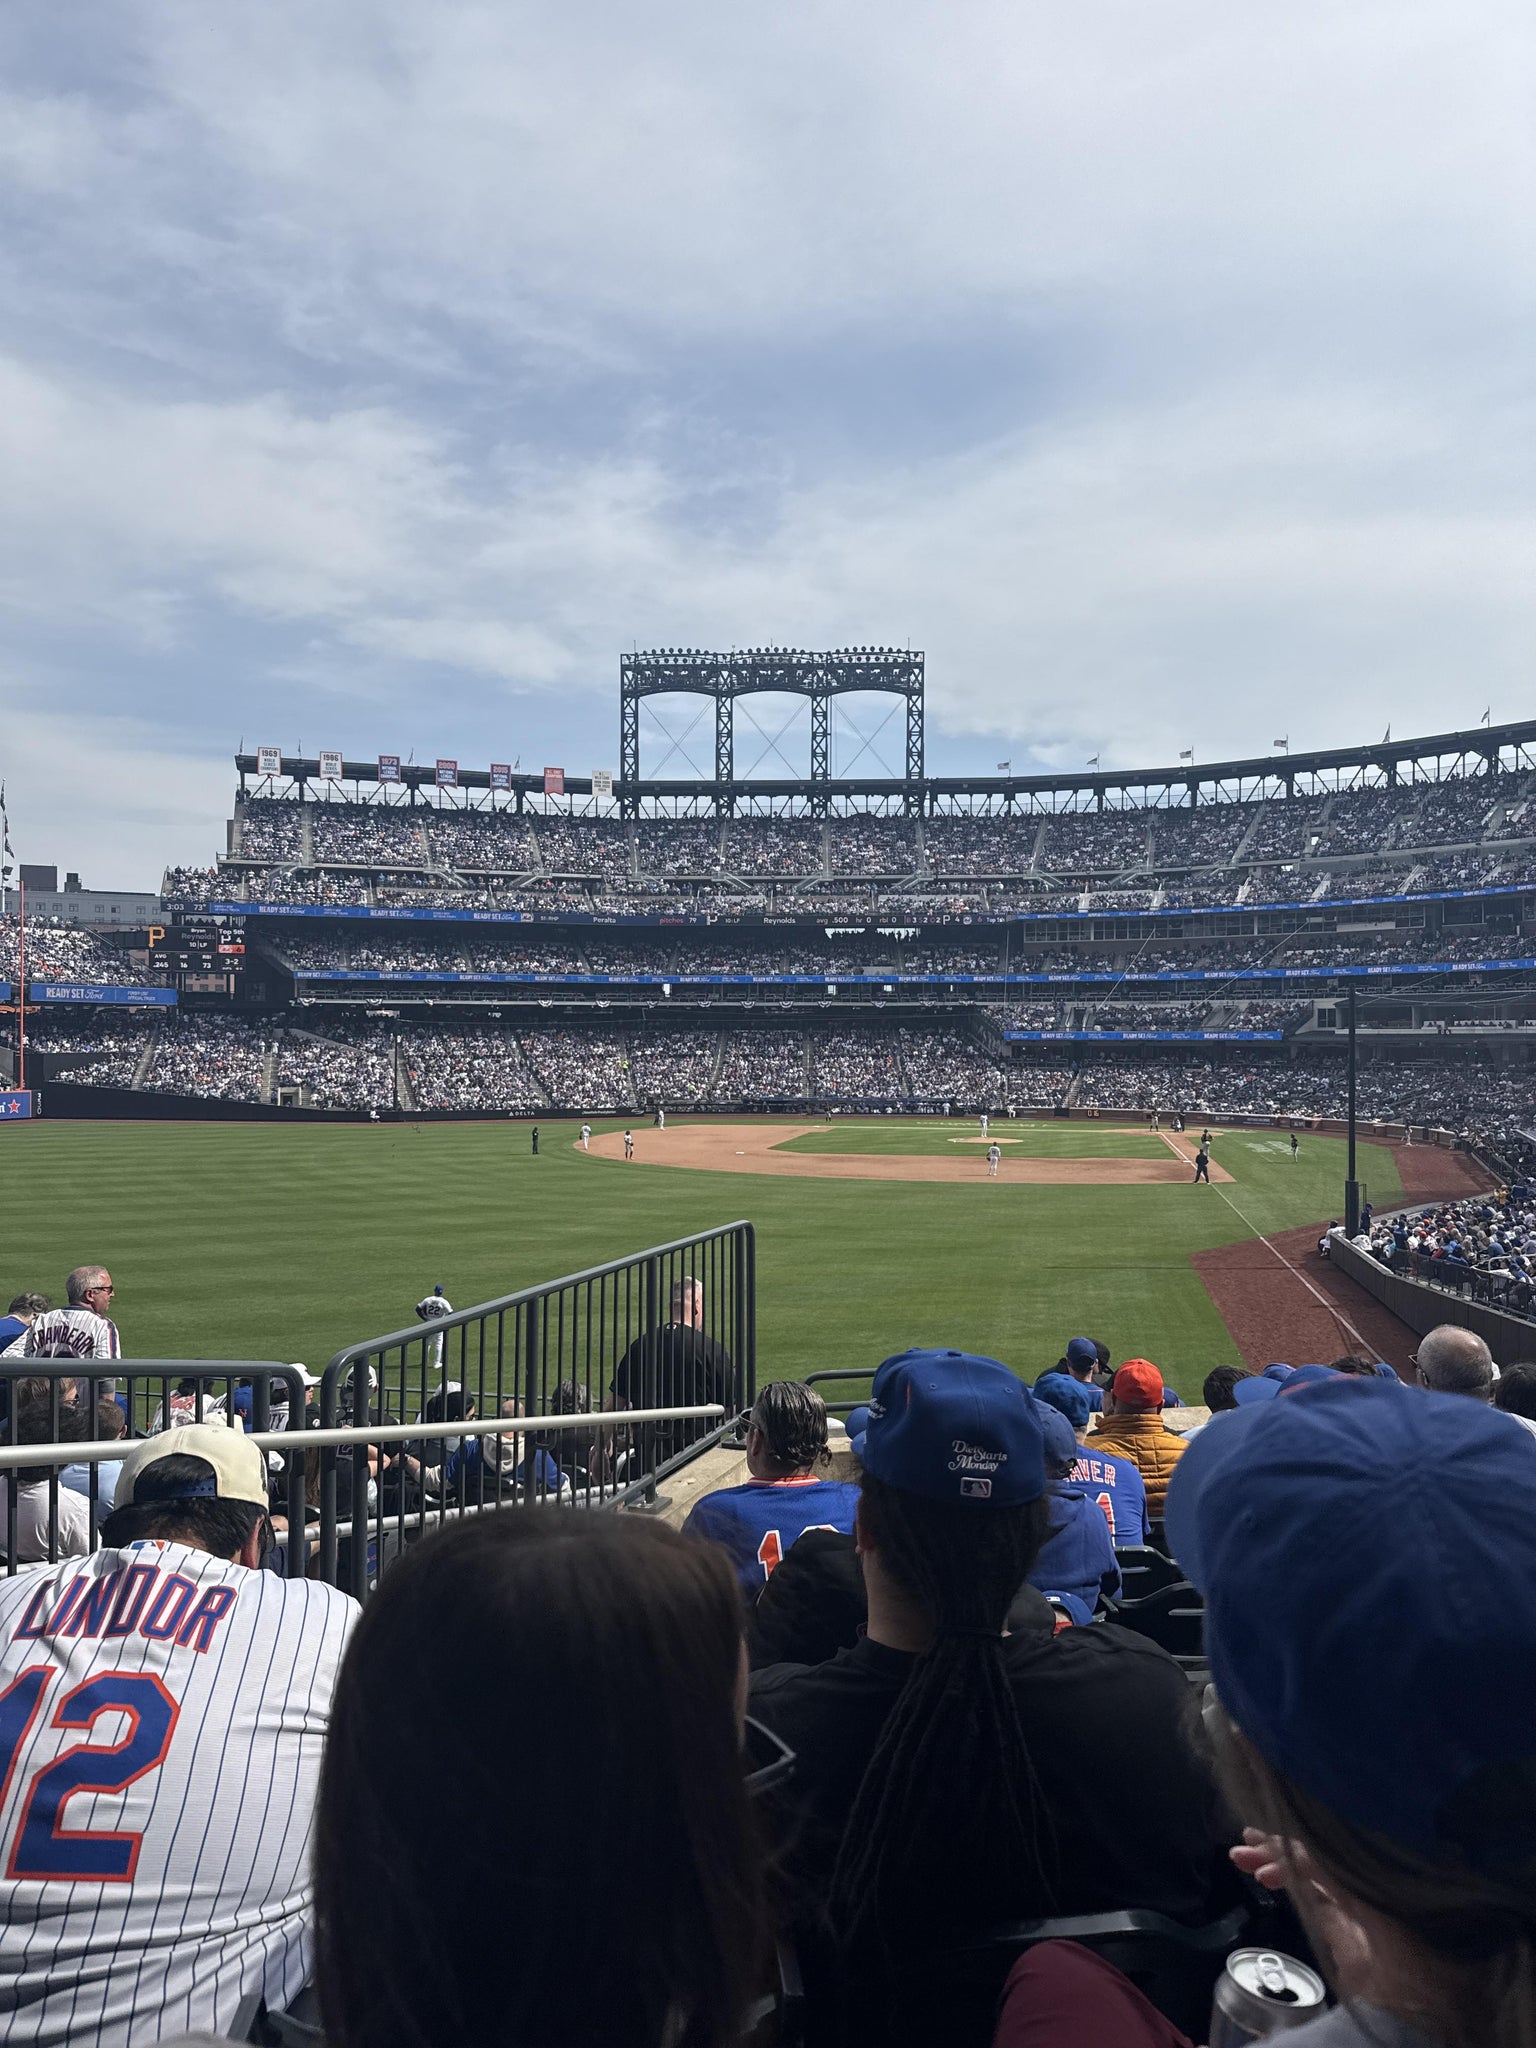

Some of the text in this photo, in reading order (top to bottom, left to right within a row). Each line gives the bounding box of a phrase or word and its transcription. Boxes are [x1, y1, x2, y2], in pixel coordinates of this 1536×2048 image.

[262, 750, 278, 758] 1969
[323, 754, 339, 762] 1986
[166, 903, 184, 911] 3:03
[370, 909, 389, 917] READY
[593, 916, 617, 924] Peralta
[659, 917, 684, 925] pitches
[763, 917, 796, 925] Reynolds
[943, 915, 951, 925] P
[148, 926, 166, 948] P
[181, 932, 216, 941] Reynolds
[46, 987, 104, 1000] READY SET Ford
[428, 1305, 441, 1316] 22
[952, 1440, 1008, 1462] Diet Starts
[947, 1454, 999, 1472] Monday
[1062, 1458, 1116, 1488] AVER
[12, 1563, 238, 1655] LINDOR
[0, 1664, 181, 1884] 12
